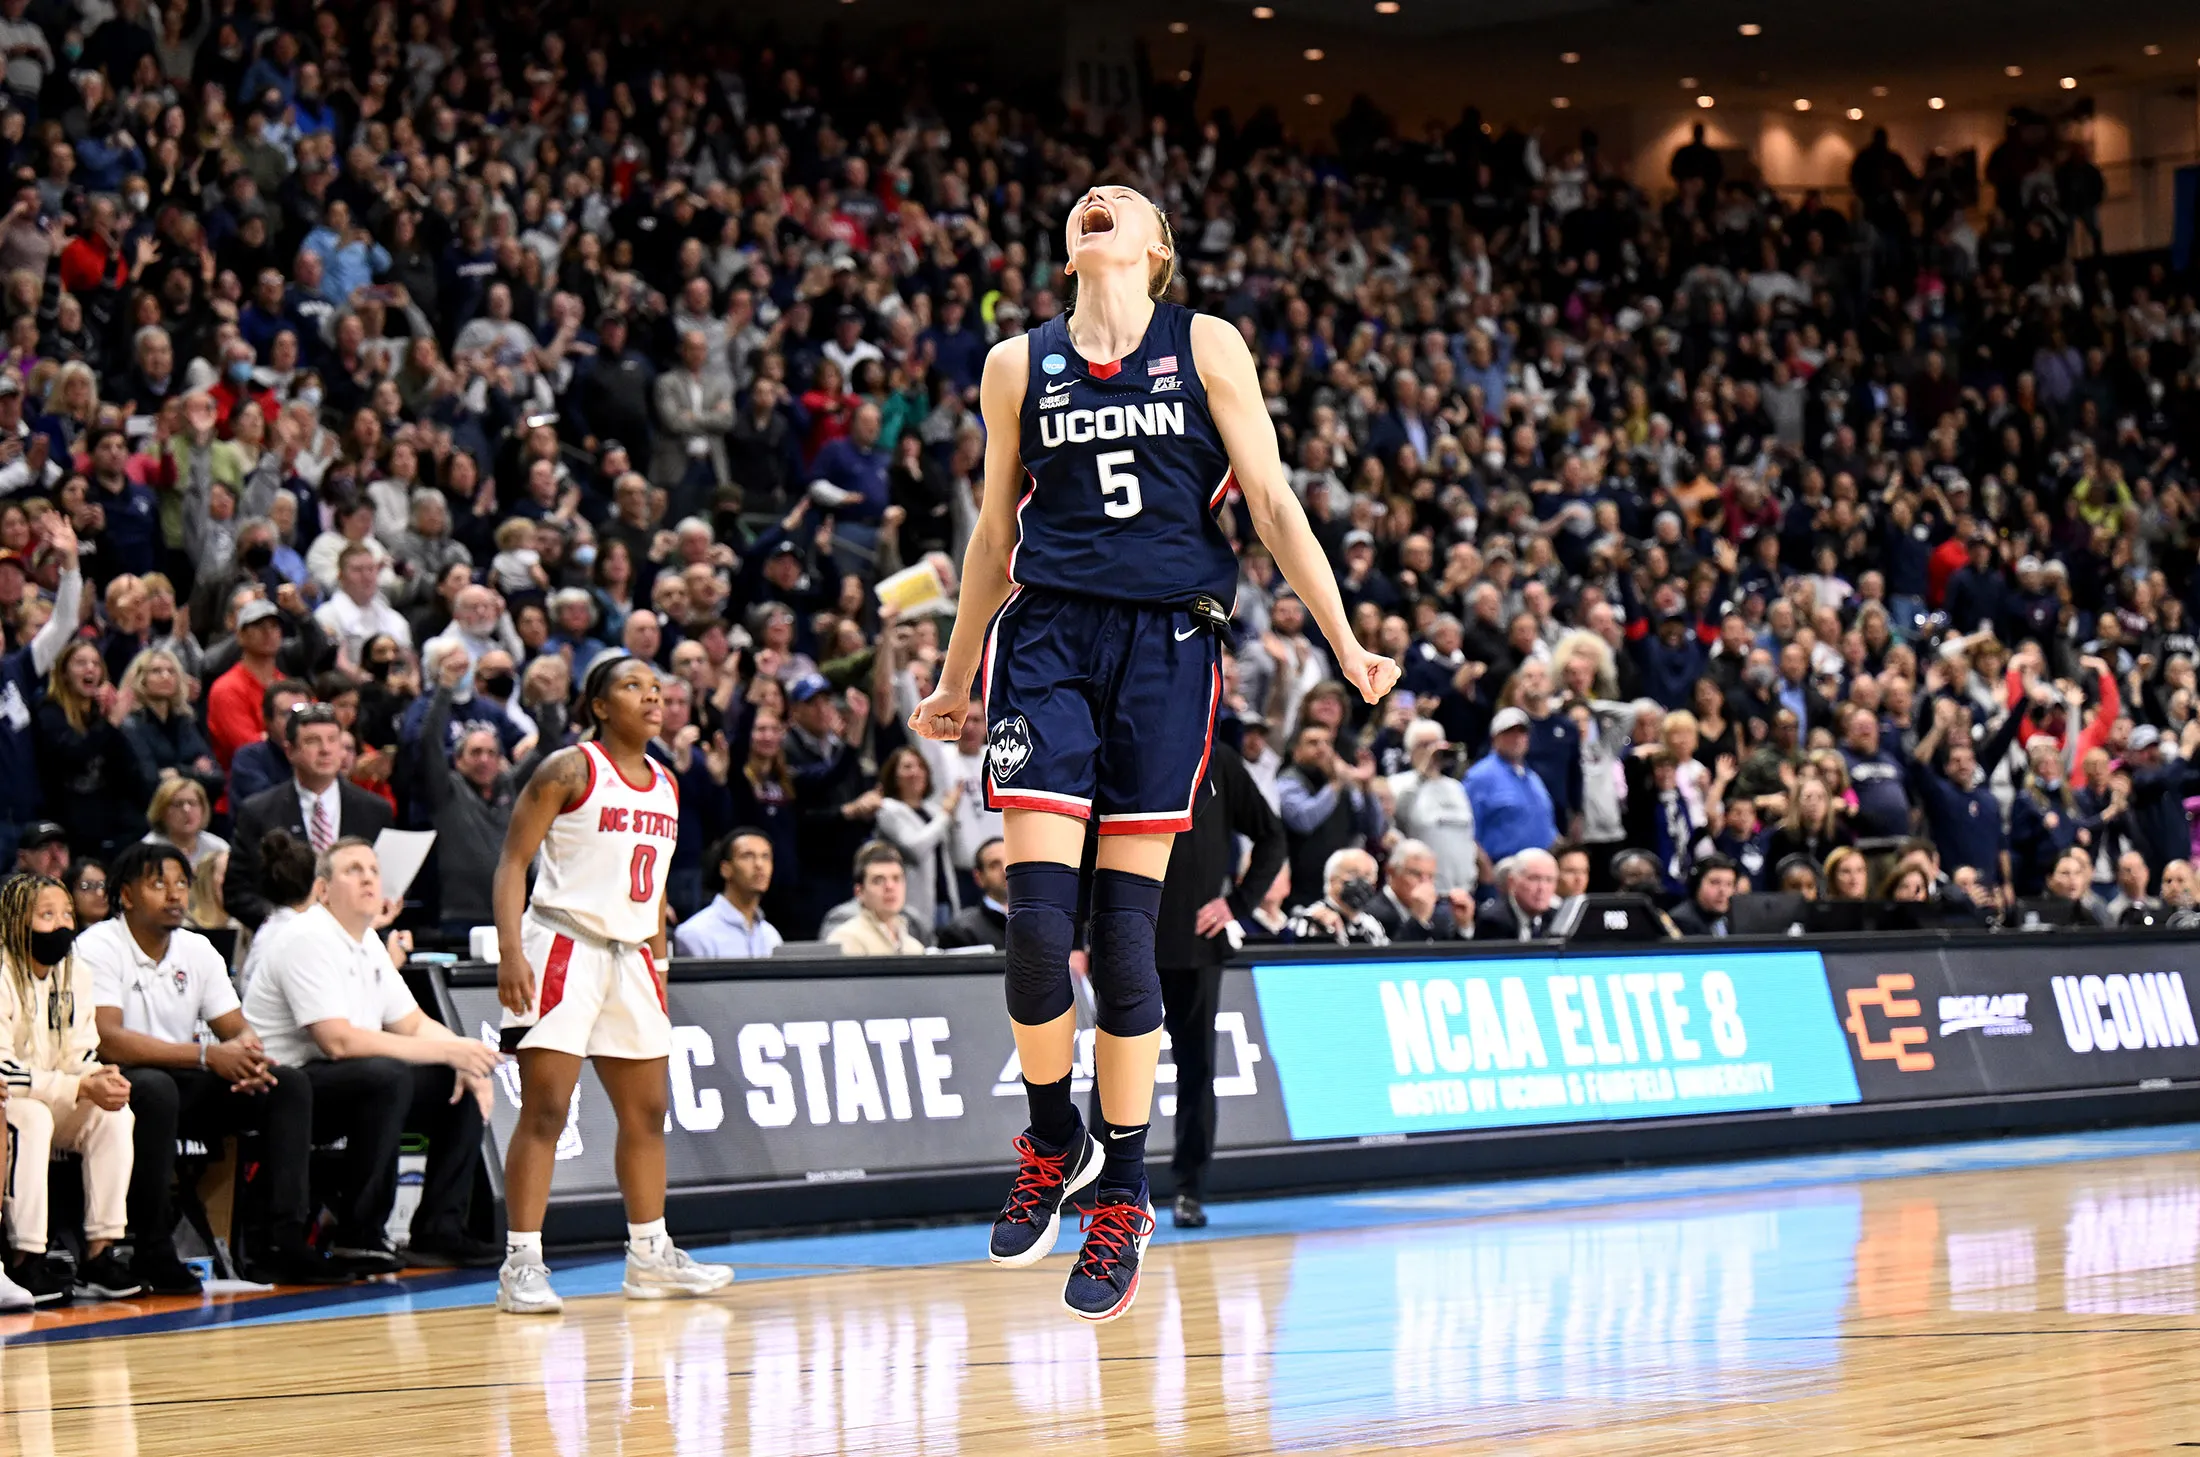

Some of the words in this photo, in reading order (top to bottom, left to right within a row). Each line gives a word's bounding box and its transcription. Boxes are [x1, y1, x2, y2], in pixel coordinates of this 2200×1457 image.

[1153, 380, 1184, 391] EAST
[1154, 375, 1177, 385] BIG
[1039, 402, 1185, 448] UCONN
[1096, 449, 1143, 519] 5
[598, 806, 629, 833] NC
[629, 843, 657, 903] 0
[1379, 976, 1549, 1076] NCAA
[1547, 971, 1702, 1067] ELITE
[1701, 970, 1748, 1058] 8
[2051, 971, 2200, 1053] UCONN
[664, 1024, 725, 1133] C
[737, 1017, 965, 1128] STATE
[1388, 1078, 1470, 1117] HOSTED
